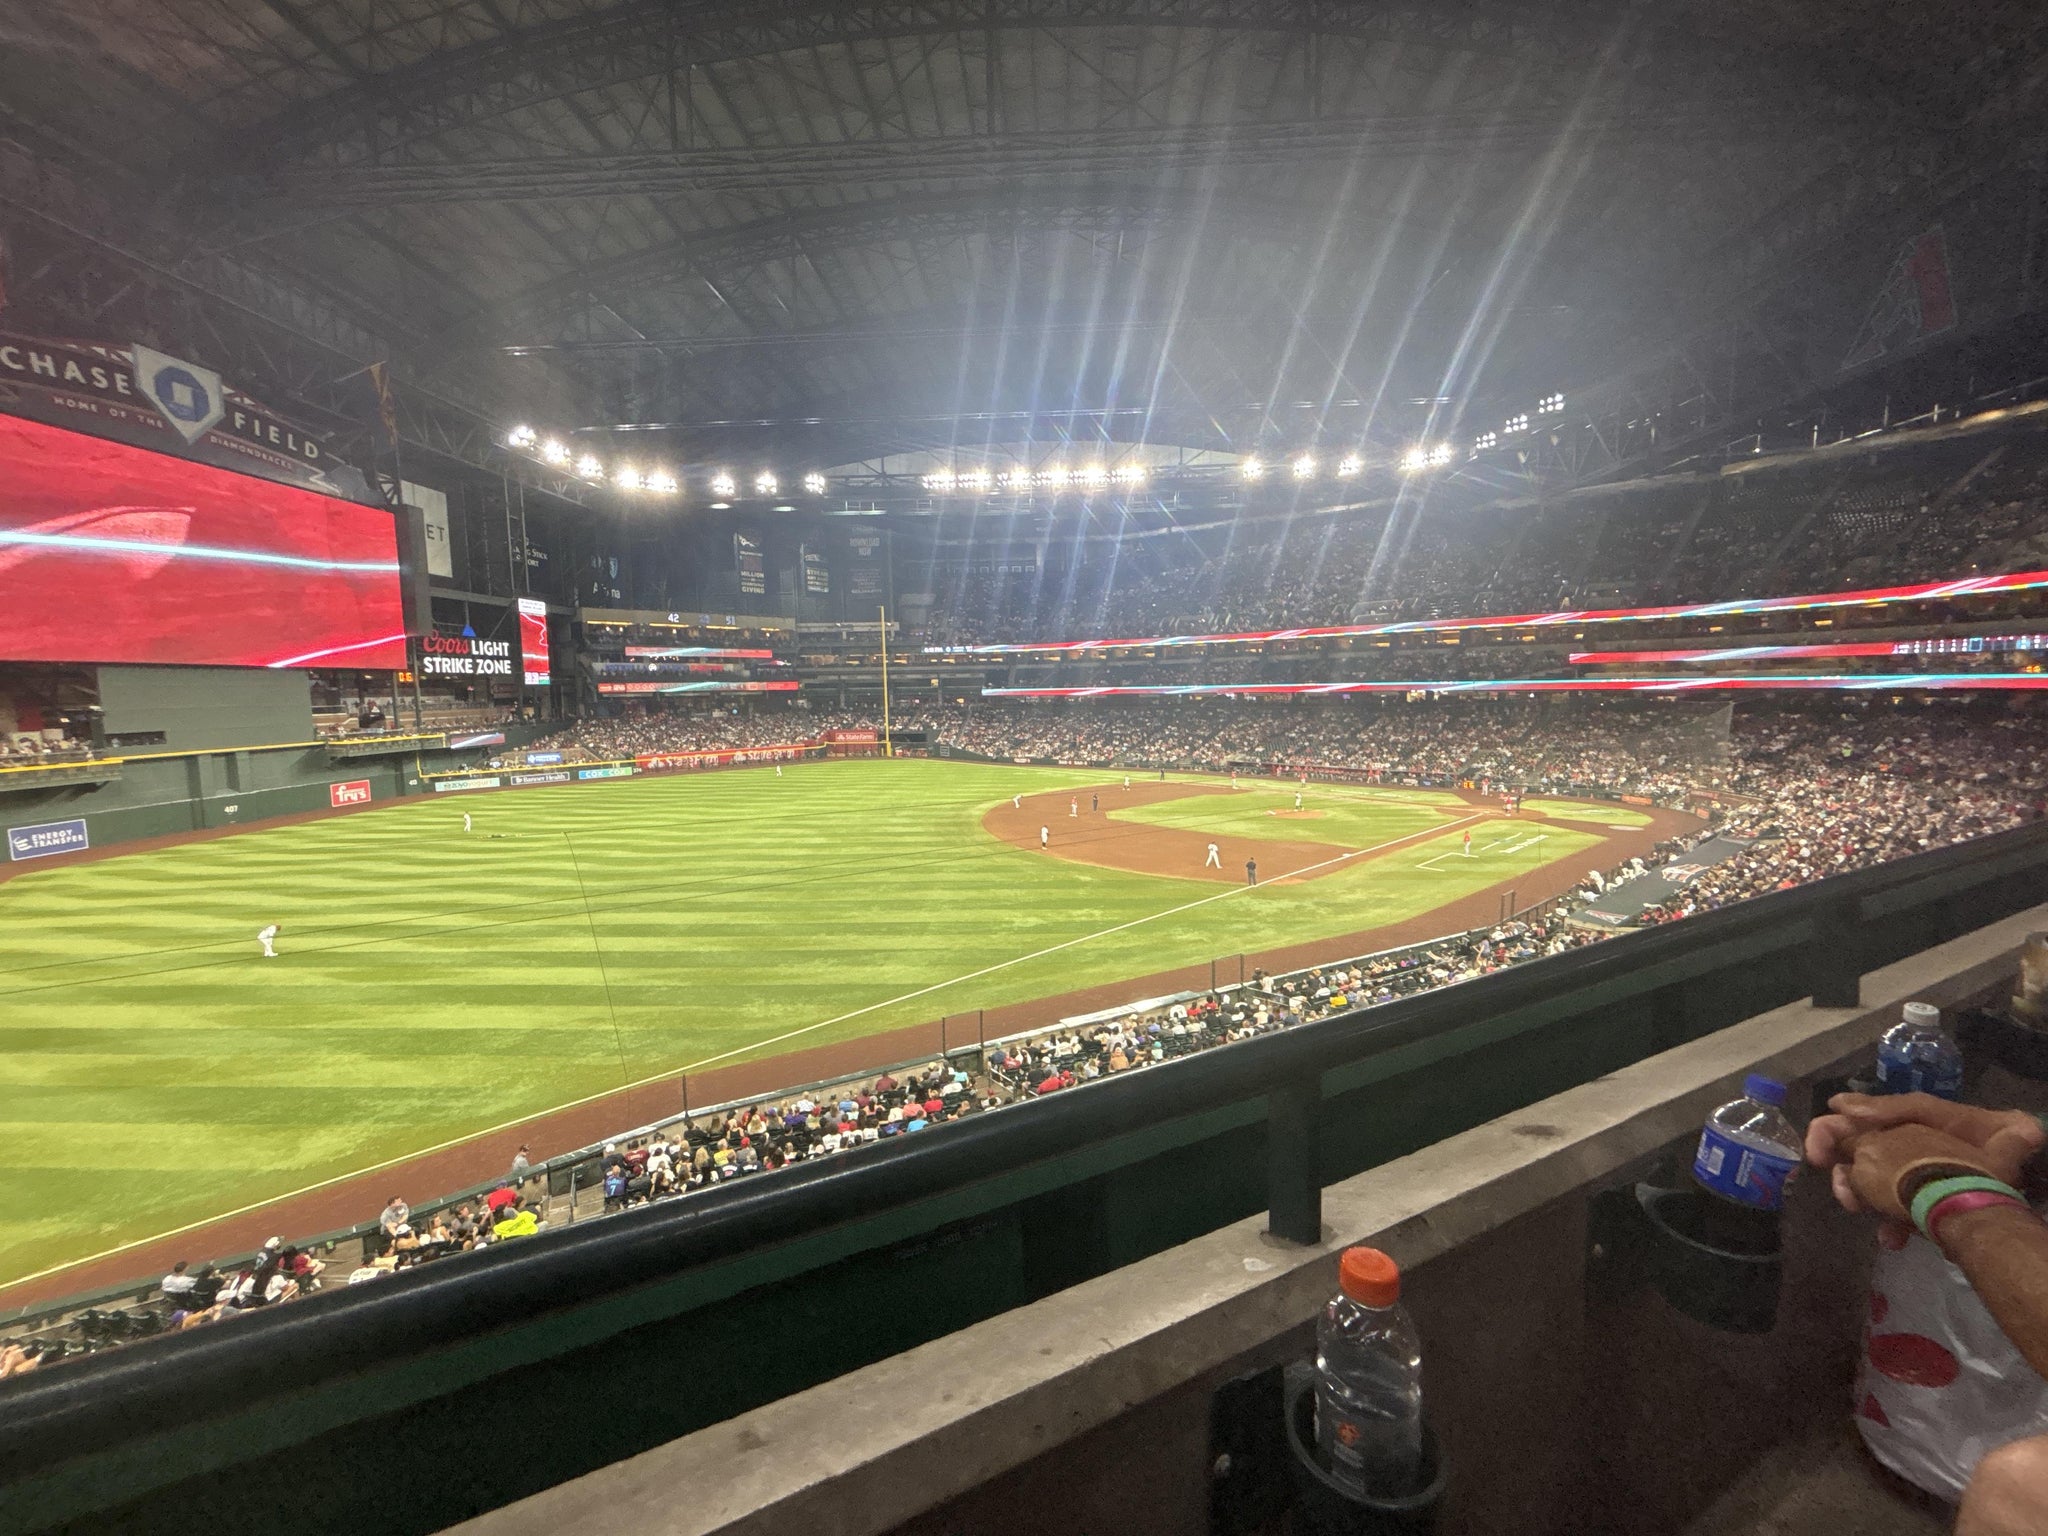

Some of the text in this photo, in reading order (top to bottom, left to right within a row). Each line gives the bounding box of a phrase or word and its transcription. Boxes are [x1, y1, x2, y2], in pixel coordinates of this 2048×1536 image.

[0, 346, 319, 459] CHASE FIELD
[53, 396, 99, 413] HOME
[109, 408, 127, 419] OF
[137, 415, 164, 429] THE
[668, 613, 680, 623] 42
[726, 615, 736, 626] 51
[423, 629, 510, 657] Coors LIGHT
[423, 657, 512, 674] STRIKE ZONE
[224, 805, 239, 813] 407
[32, 829, 72, 841] ENERGY
[32, 835, 84, 849] TRANSFER
